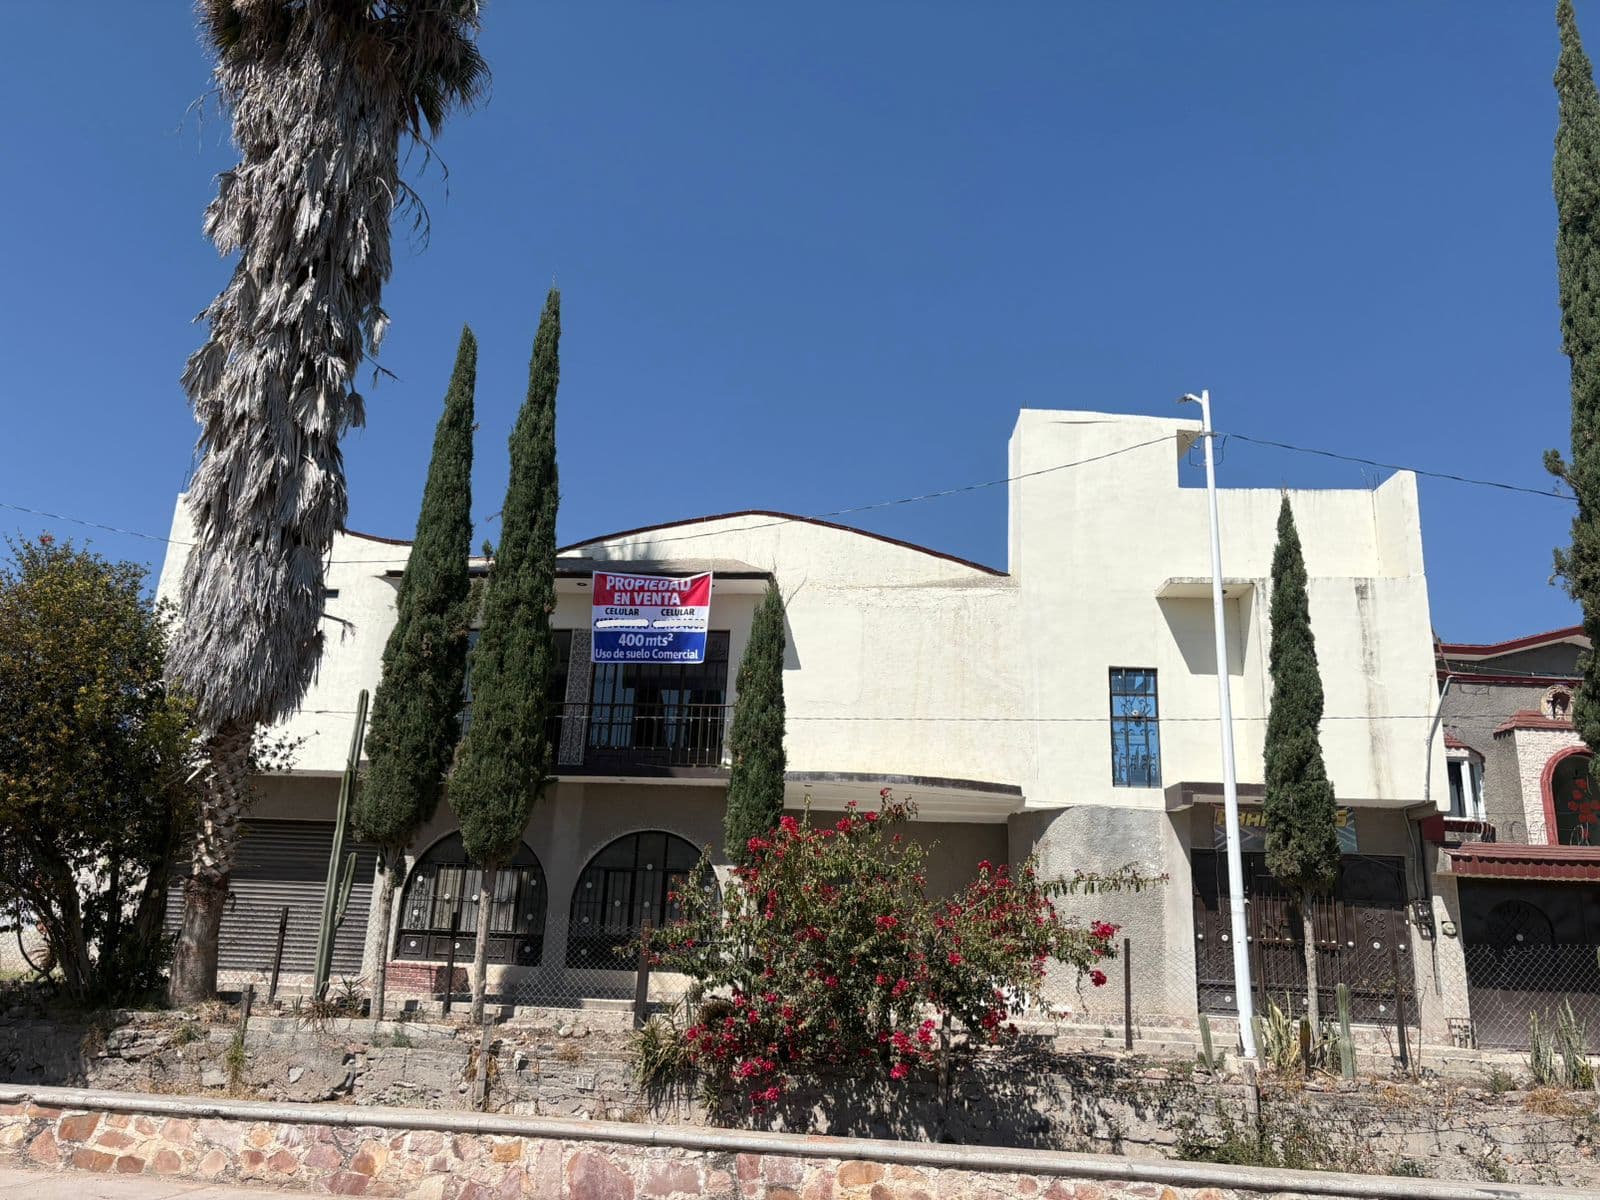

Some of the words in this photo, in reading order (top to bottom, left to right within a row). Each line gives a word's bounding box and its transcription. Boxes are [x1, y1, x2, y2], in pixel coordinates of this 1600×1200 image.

[606, 576, 692, 591] PROPIEDAD
[614, 592, 630, 604] EN
[634, 592, 681, 605] VENTA
[605, 607, 640, 616] CELULAR
[661, 608, 695, 616] CELULAR
[618, 634, 644, 646] 400
[595, 649, 612, 659] Uso
[613, 649, 624, 659] de
[625, 649, 650, 659] suelo
[652, 649, 698, 659] Comercial
